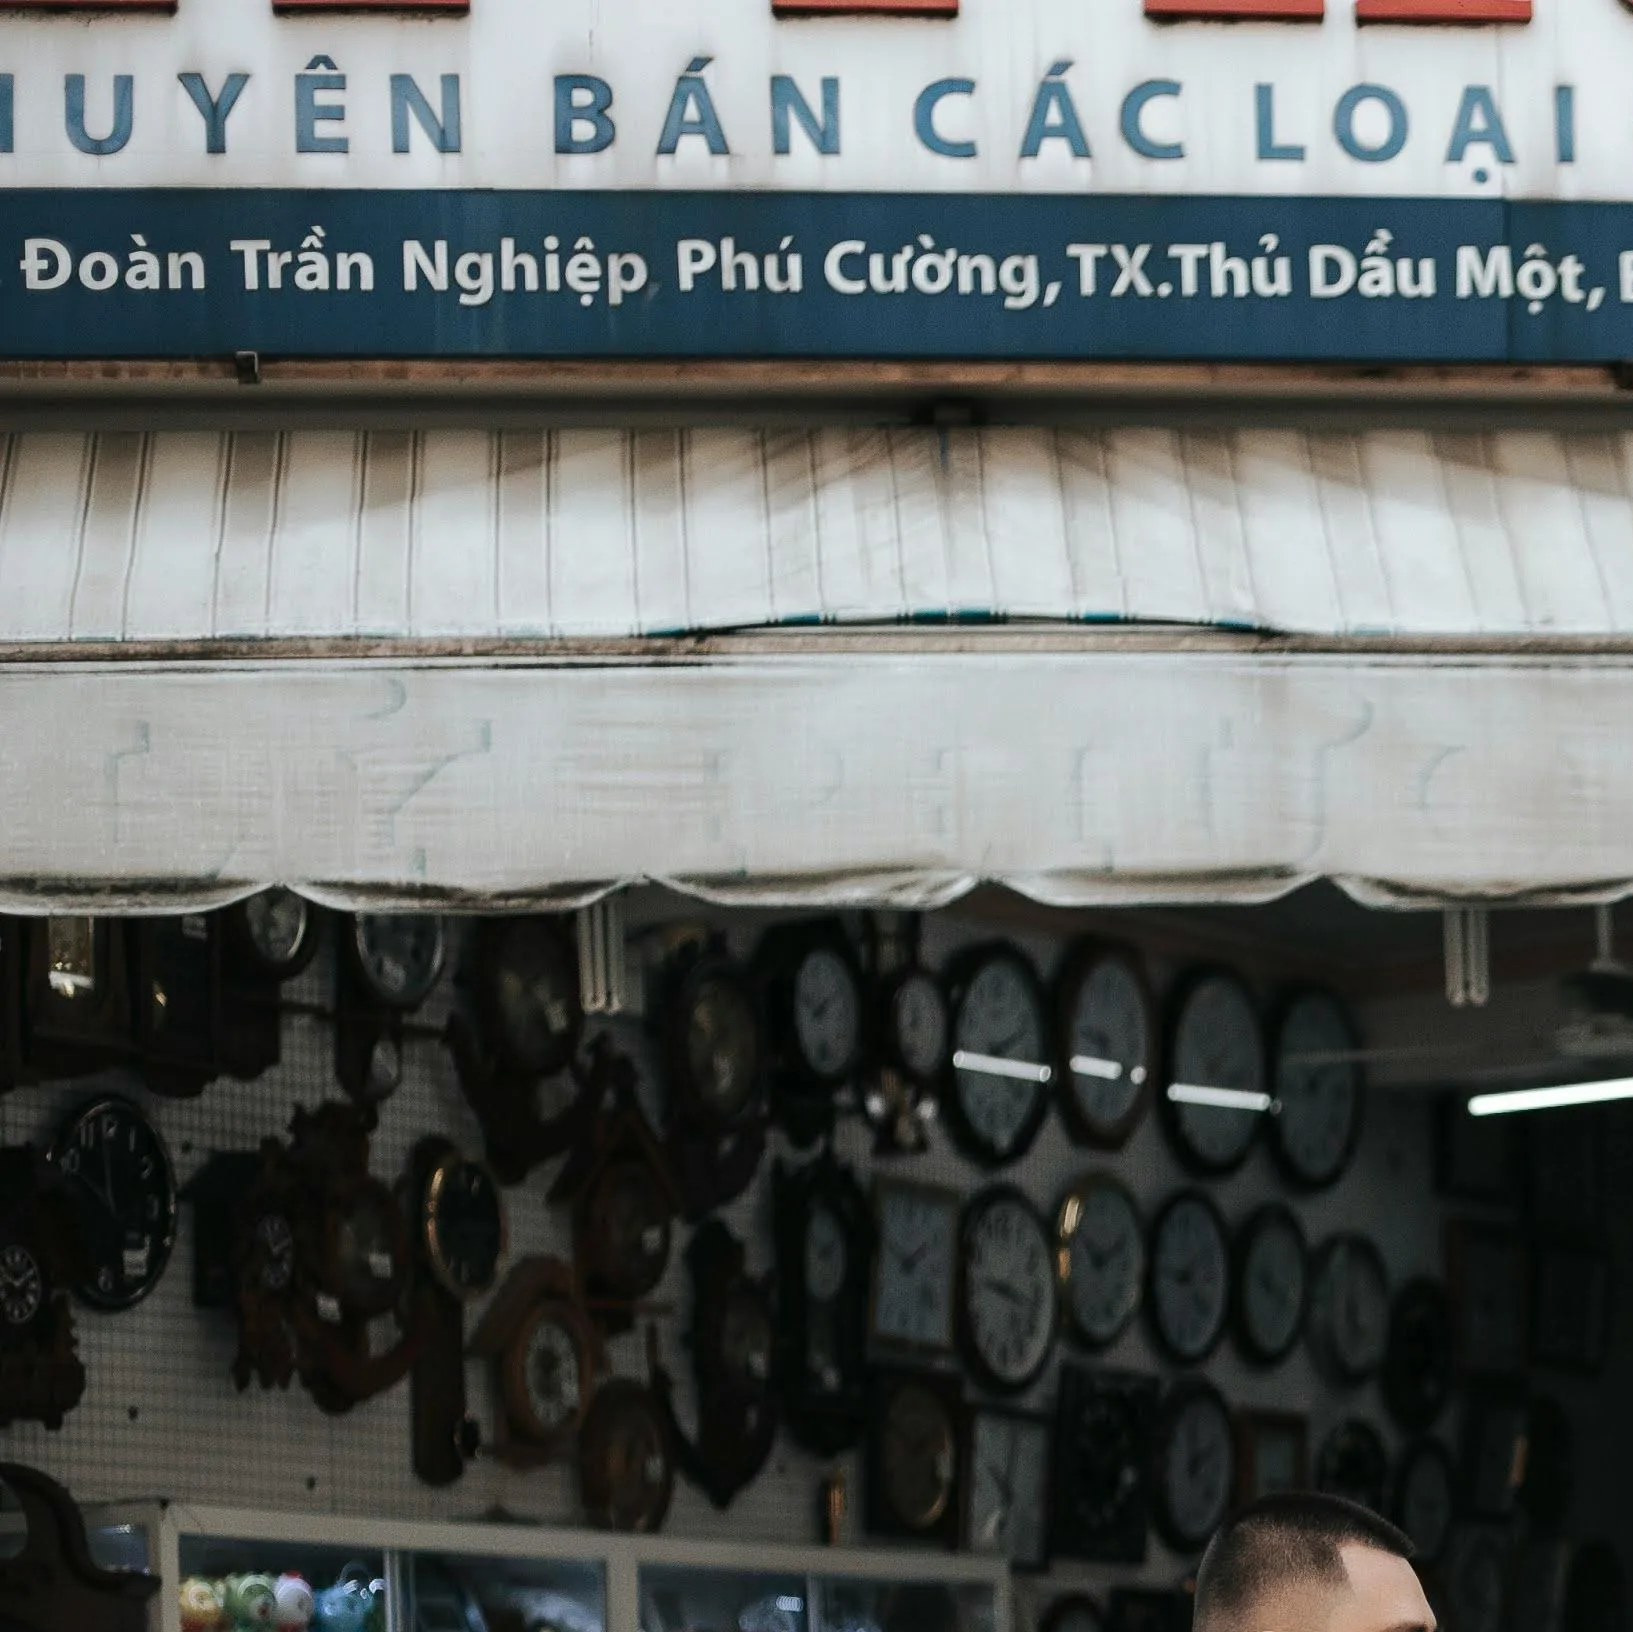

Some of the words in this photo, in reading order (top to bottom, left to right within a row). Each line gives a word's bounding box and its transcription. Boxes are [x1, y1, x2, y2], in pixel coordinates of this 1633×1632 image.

[0, 56, 463, 156] UYÊN
[551, 57, 841, 156] BÁN
[914, 61, 1185, 160] CÁC
[1255, 83, 1575, 184] LOẠI
[20, 236, 206, 291] Đoàn
[230, 226, 375, 292] Trần
[402, 236, 648, 307] Nghiệp
[677, 234, 802, 293] Phú
[1308, 230, 1435, 300] Dầu
[1455, 244, 1604, 314] Một,
